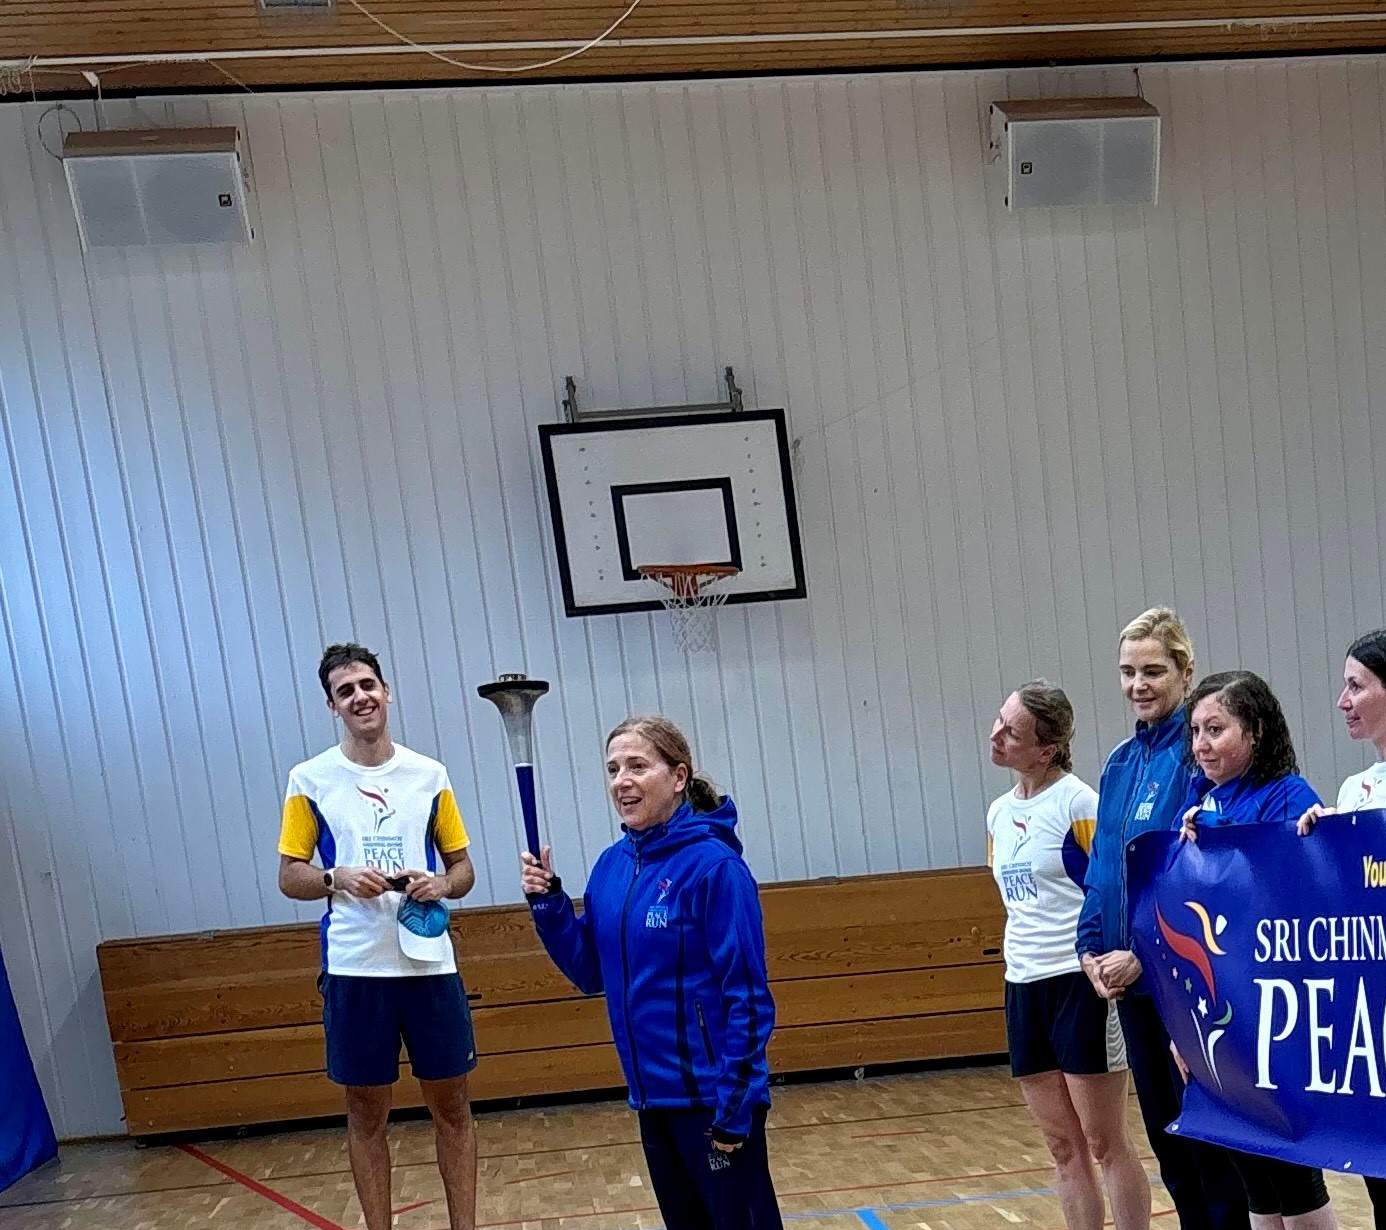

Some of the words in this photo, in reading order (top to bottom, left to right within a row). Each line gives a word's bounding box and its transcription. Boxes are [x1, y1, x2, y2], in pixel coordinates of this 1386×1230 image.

[363, 847, 405, 860] PEACE
[1002, 872, 1036, 888] PEACE
[1005, 882, 1038, 902] RUN
[1254, 917, 1302, 963] SRI
